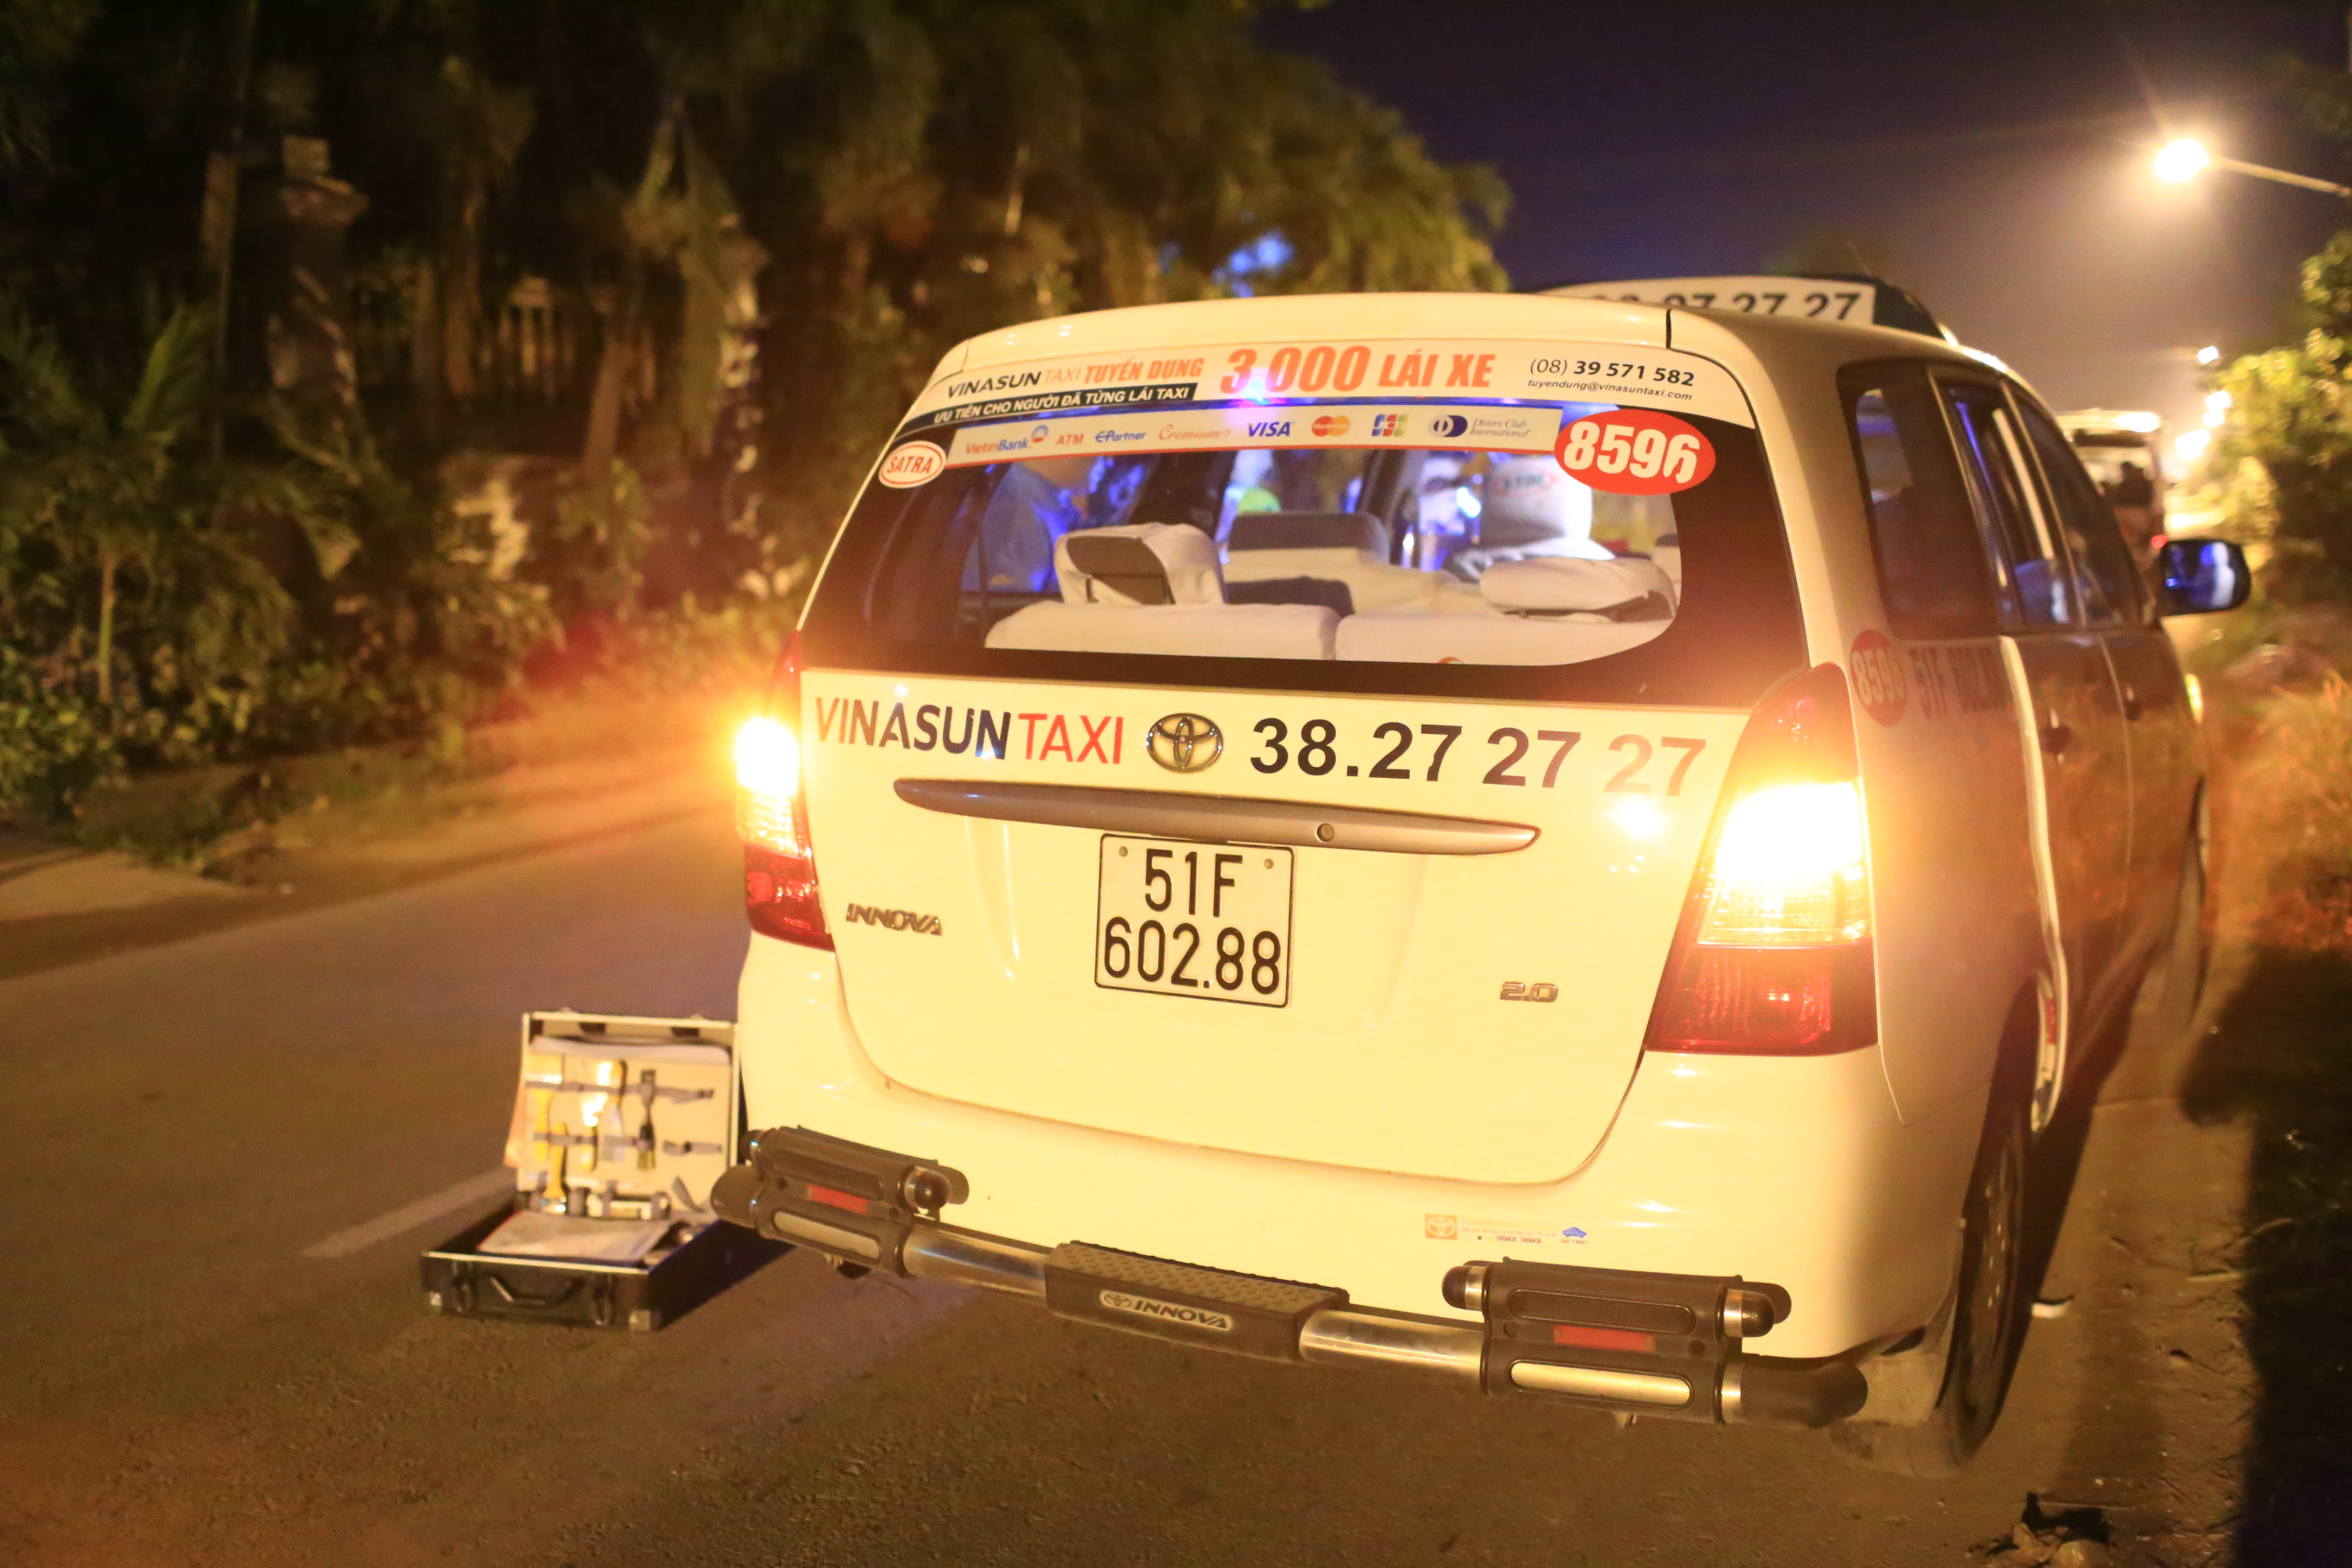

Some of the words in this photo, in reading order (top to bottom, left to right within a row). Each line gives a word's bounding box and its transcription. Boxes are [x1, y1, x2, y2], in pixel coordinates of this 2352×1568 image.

[1805, 292, 1861, 320] 27
[1147, 358, 1205, 383] DỤNG
[1378, 348, 1439, 388] LÁI
[1445, 353, 1496, 388] XE
[1530, 358, 1568, 376] (08)
[1573, 360, 1601, 376] 39
[1606, 363, 1645, 379] 571
[1653, 367, 1694, 387] 582
[983, 401, 1012, 416] CHO
[1013, 394, 1060, 412] NGƯỜI
[1060, 391, 1081, 407] ĐÃ
[1085, 390, 1125, 405] TỪNG
[1128, 386, 1154, 401] LÁI
[1156, 388, 1189, 401] TAXI
[1528, 379, 1693, 401] tuyendung@vinasuntaxi.com
[1247, 421, 1291, 438] VISA
[1504, 420, 1528, 429] Club
[966, 438, 1029, 454] VietinBank
[1056, 433, 1085, 446] ATM
[1564, 421, 1701, 485] 8596
[886, 456, 934, 474] SATRA
[816, 696, 1011, 760] VINASUN
[1018, 713, 1124, 765] TAXI
[1250, 717, 1463, 782] 38.27
[1482, 727, 1582, 788] 27
[1603, 734, 1707, 797] 27
[1144, 848, 1243, 917] 51F
[845, 903, 943, 936] INNOVA
[1104, 916, 1282, 995] 602.88
[1499, 981, 1559, 1003] 2.0
[1134, 1300, 1228, 1331] INNOVA
